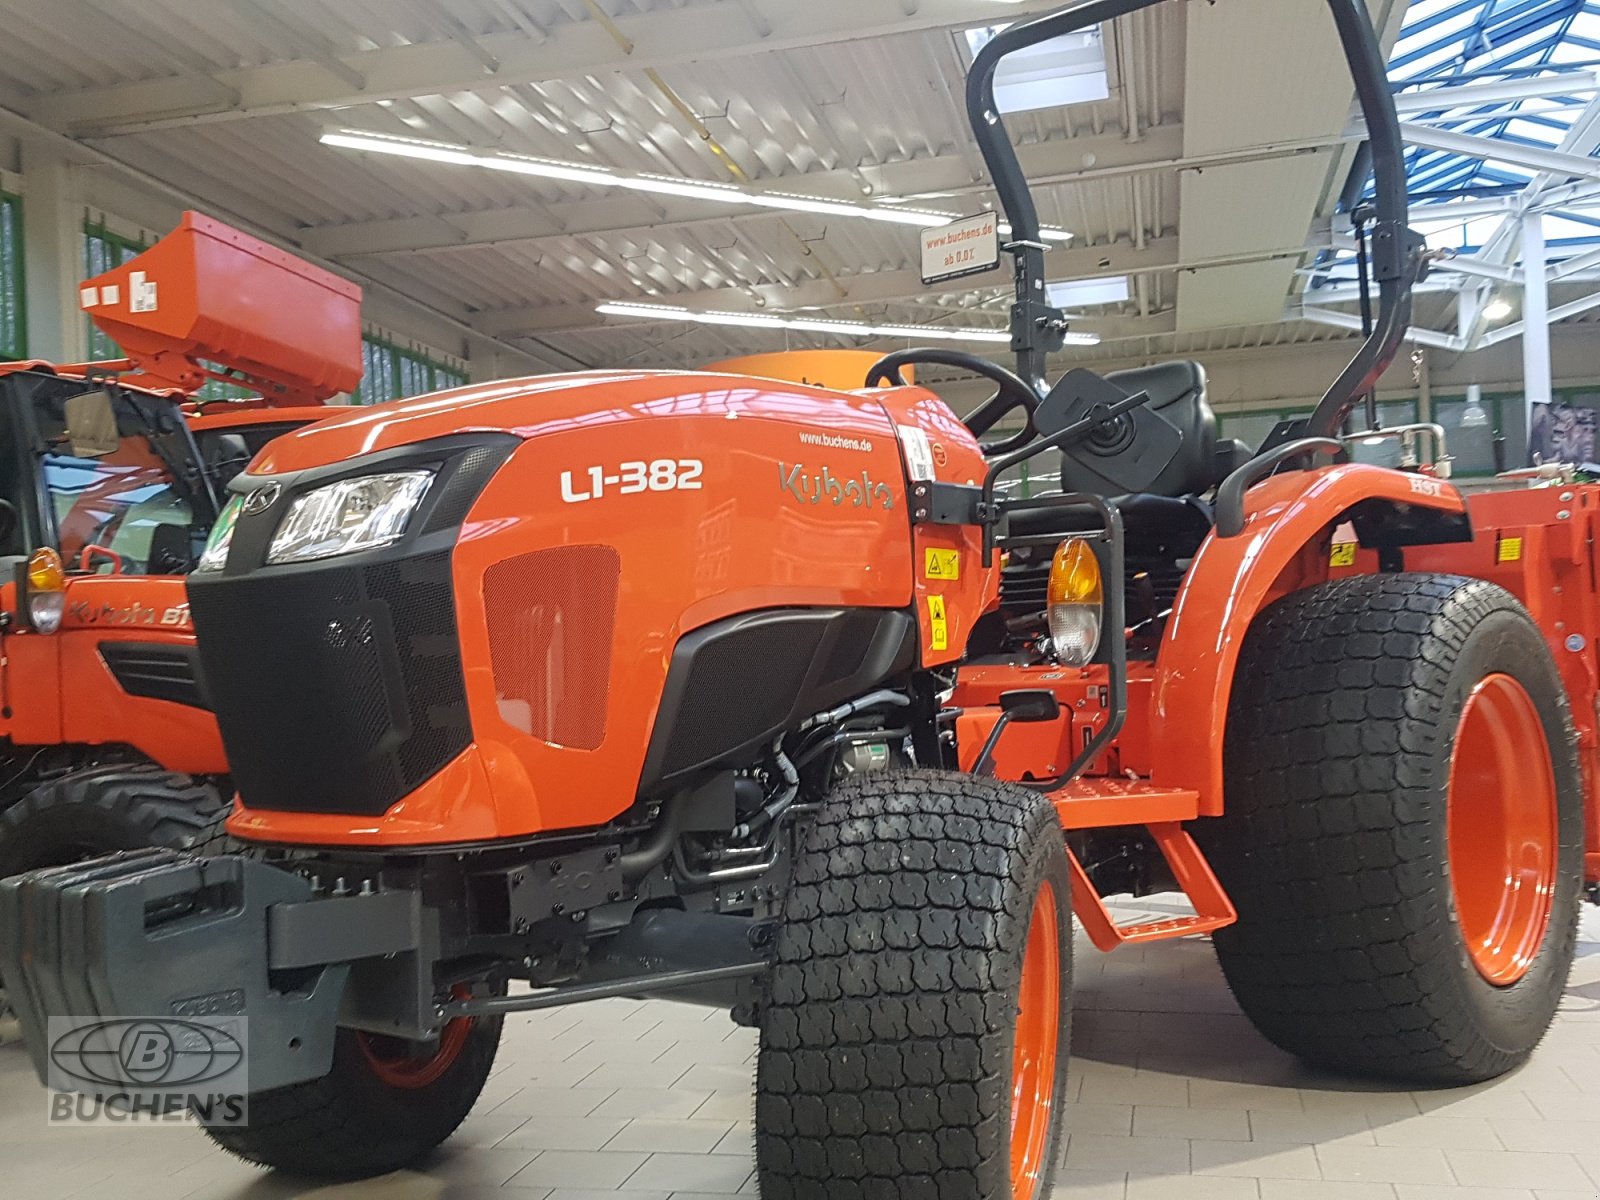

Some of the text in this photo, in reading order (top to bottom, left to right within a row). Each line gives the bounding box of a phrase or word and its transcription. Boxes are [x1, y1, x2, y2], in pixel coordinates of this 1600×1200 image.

[926, 223, 993, 249] www.buchens.de
[944, 253, 954, 266] ab
[799, 432, 873, 452] www.buchens.de
[560, 458, 703, 503] L1-382
[778, 462, 894, 510] Kubota
